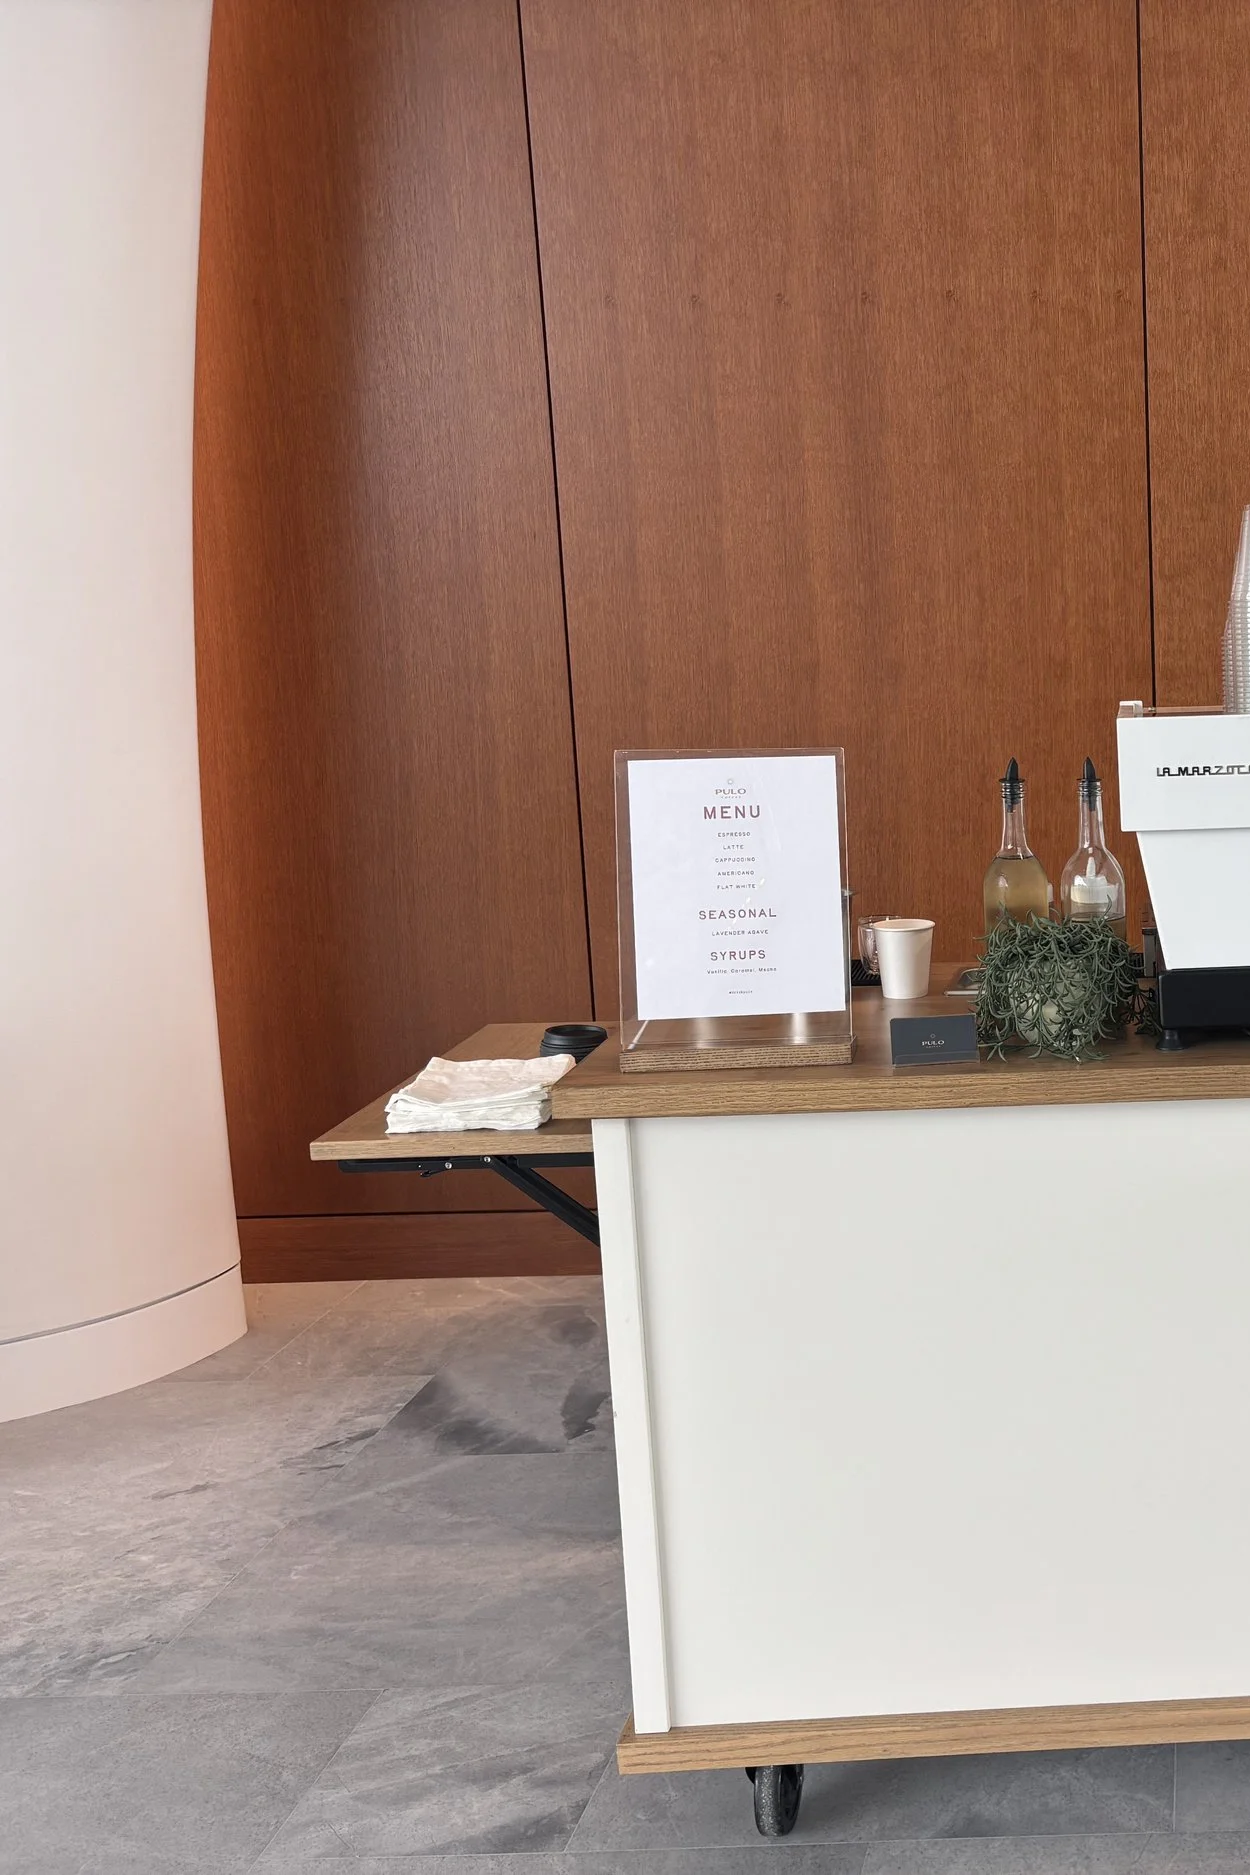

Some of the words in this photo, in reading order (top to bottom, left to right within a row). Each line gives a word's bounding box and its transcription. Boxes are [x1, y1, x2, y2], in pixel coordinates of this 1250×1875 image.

[715, 788, 747, 796] PULO
[703, 805, 760, 819] MENU
[698, 908, 777, 920] SEASONAL
[710, 949, 766, 961] SYRUPS
